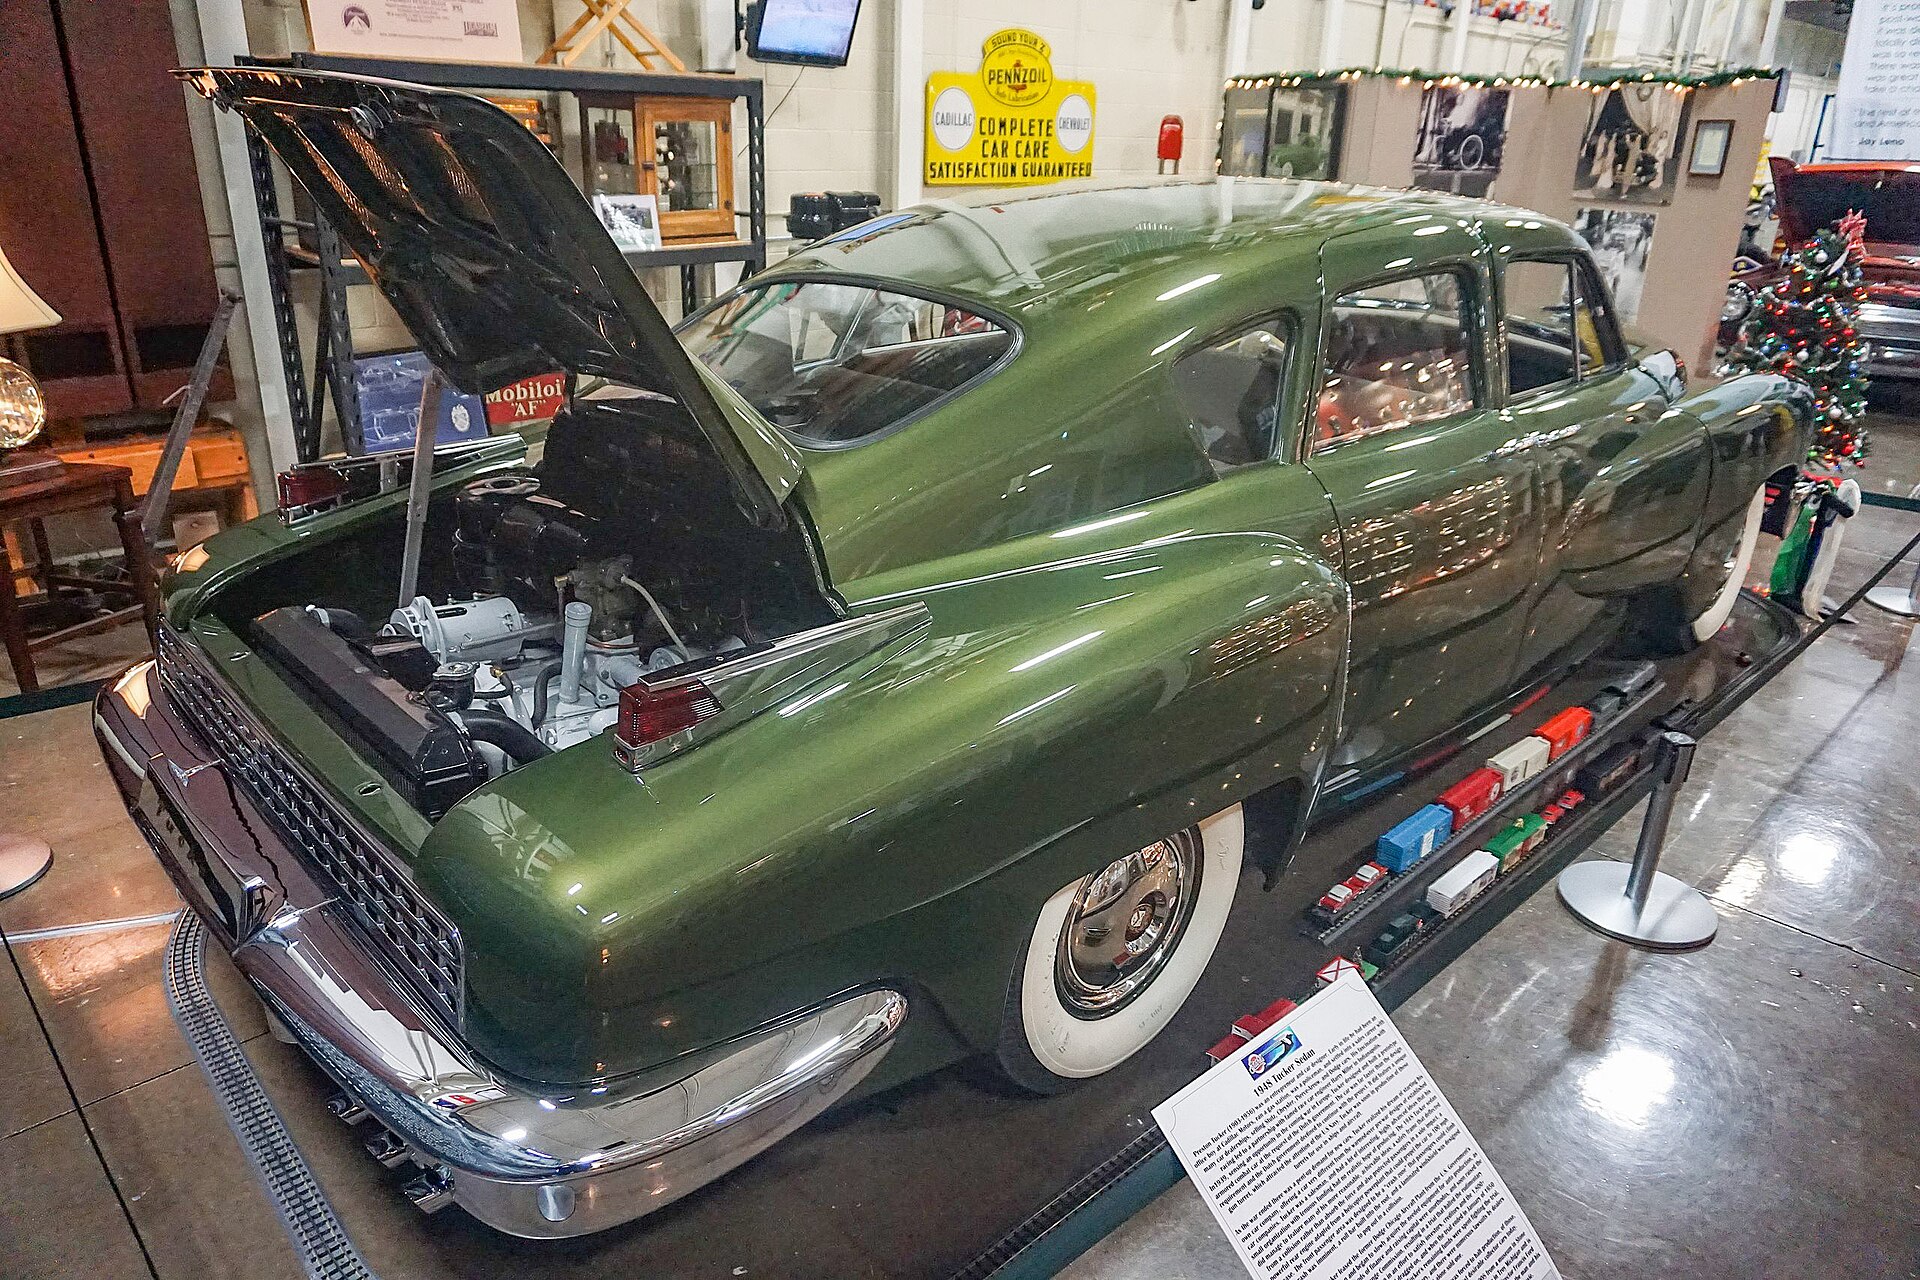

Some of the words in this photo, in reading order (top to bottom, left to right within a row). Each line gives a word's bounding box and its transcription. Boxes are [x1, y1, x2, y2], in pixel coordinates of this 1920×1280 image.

[991, 33, 1016, 47] SOUND
[1019, 33, 1039, 45] YOUR
[988, 68, 1048, 85] PENNZOIL
[935, 111, 973, 127] CADILLAC
[979, 117, 1053, 137] COMPLETE
[1059, 116, 1090, 130] CHEVROLET
[982, 140, 1009, 158] CAR
[1015, 140, 1050, 158] CARE
[1858, 137, 1876, 146] Jay
[1879, 137, 1905, 145] Leno
[930, 162, 1017, 178] SATISFACTION
[1022, 162, 1092, 177] GUARANTEED
[1254, 1079, 1272, 1096] 1948
[1272, 1063, 1294, 1082] Tucker
[1294, 1049, 1315, 1066] Sedan
[1192, 1142, 1211, 1157] Preston
[1210, 1130, 1226, 1143] Tucker
[1254, 1102, 1264, 1110] was
[1270, 1077, 1295, 1099] entrepreneur
[1296, 1070, 1304, 1079] and
[1328, 1045, 1338, 1054] Early
[1194, 1156, 1206, 1168] office
[1206, 1150, 1216, 1158] boy
[1220, 1132, 1238, 1147] Cadillac
[1238, 1121, 1255, 1132] Motors,
[1255, 1113, 1263, 1121] ran
[1266, 1104, 1275, 1113] gas
[1323, 1060, 1331, 1068] and
[1331, 1050, 1344, 1062] settled
[1203, 1161, 1216, 1172] many
[1216, 1154, 1224, 1162] car
[1224, 1136, 1251, 1156] dealerships,
[1250, 1122, 1266, 1135] selling
[1321, 1072, 1329, 1081] and
[1328, 1064, 1341, 1074] Dodge
[1228, 1160, 1246, 1176] sensing
[1252, 1137, 1276, 1157] opportunity
[1288, 1114, 1304, 1128] coming
[1303, 1108, 1311, 1116] war
[1330, 1082, 1344, 1094] Tucker
[1240, 1222, 1249, 1230] the
[1249, 1214, 1258, 1223] war
[1258, 1201, 1272, 1215] ended
[1271, 1192, 1283, 1204] there
[1283, 1185, 1292, 1194] was
[1311, 1154, 1328, 1170] demand
[1334, 1143, 1342, 1151] new
[1352, 1123, 1365, 1135] Tucker
[1366, 1109, 1381, 1124] realized
[1266, 1259, 1278, 1271] from
[1282, 1240, 1300, 1258] collision
[1300, 1227, 1314, 1241] rather
[1313, 1218, 1324, 1229] than
[1324, 1205, 1338, 1220] absorb
[1337, 1199, 1345, 1207] the
[1344, 1189, 1356, 1201] force
[1356, 1181, 1364, 1191] and
[1364, 1174, 1373, 1184] also
[1372, 1158, 1390, 1177] protected
[1390, 1141, 1411, 1161] passengers
[1337, 1258, 1352, 1274] leased
[1351, 1253, 1359, 1261] the
[1358, 1240, 1373, 1254] former
[1372, 1228, 1385, 1241] Dodge
[1385, 1213, 1401, 1229] Chicago
[1400, 1198, 1416, 1213] Aircraft
[1414, 1189, 1426, 1201] Plant
[1424, 1181, 1435, 1191] from
[1457, 1260, 1470, 1275] forced
[1473, 1248, 1482, 1258] halt
